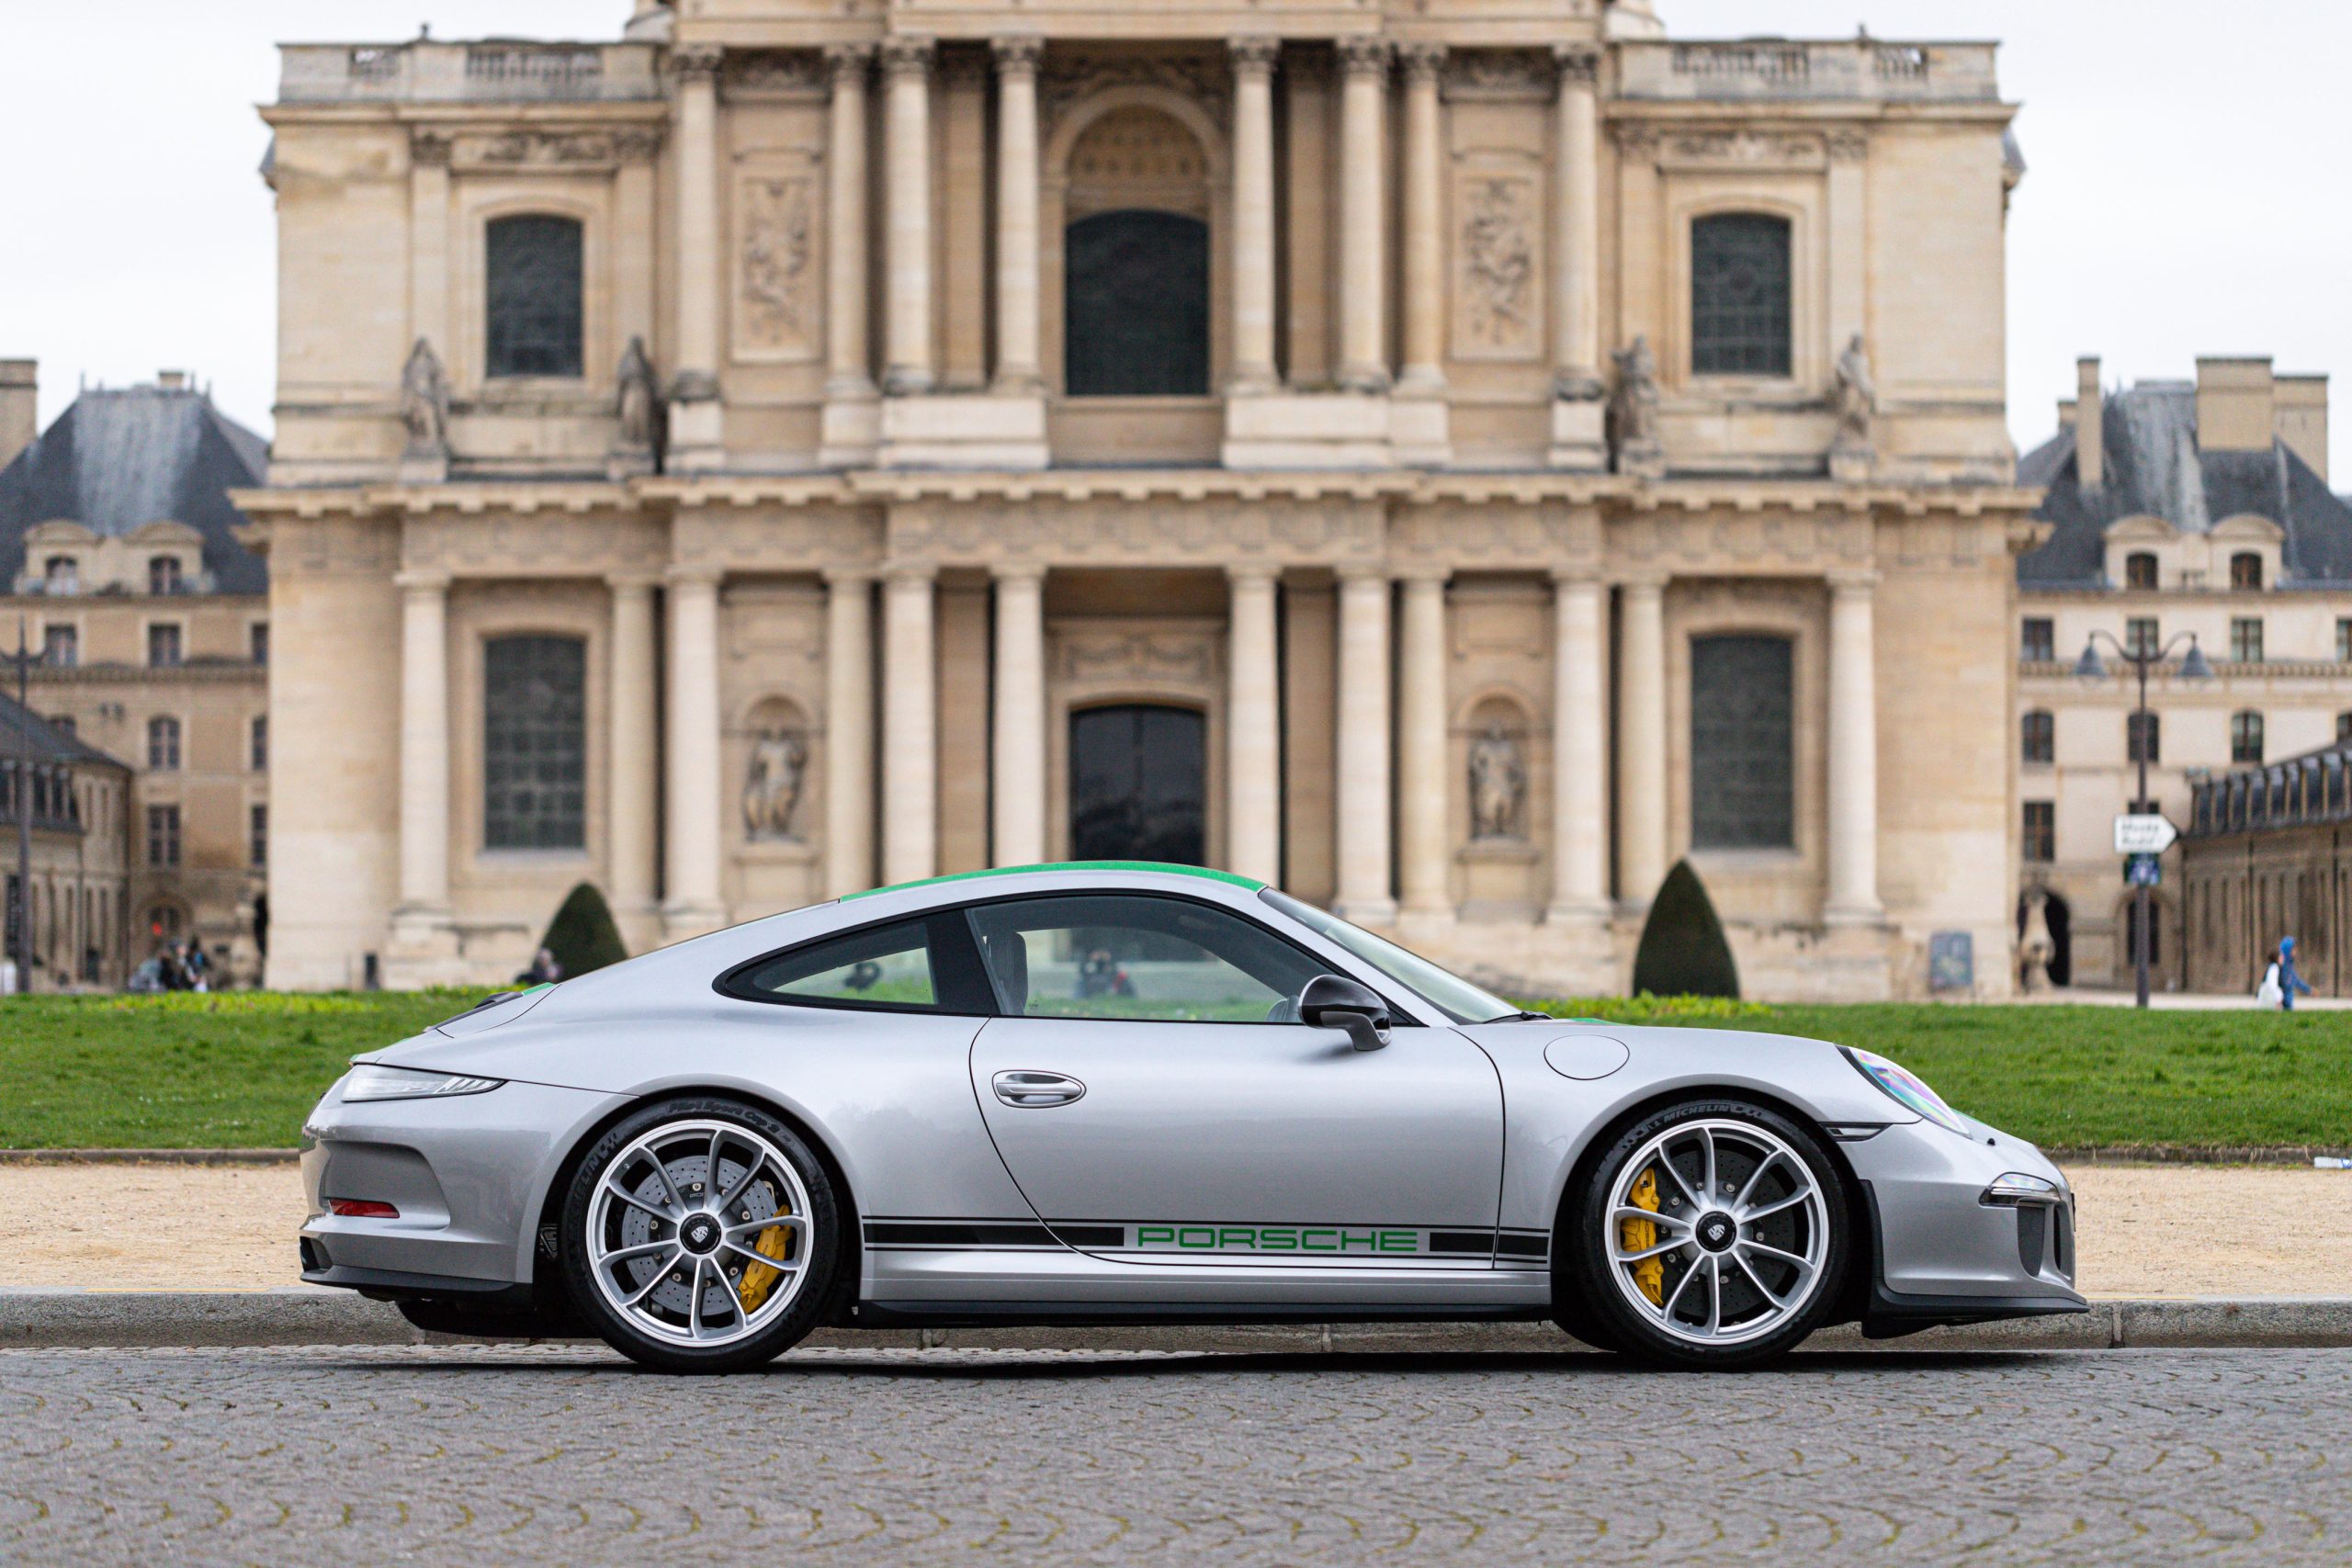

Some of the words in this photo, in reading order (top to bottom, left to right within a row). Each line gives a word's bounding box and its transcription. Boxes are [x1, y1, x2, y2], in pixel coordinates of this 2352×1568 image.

[669, 1101, 703, 1113] Pilot
[703, 1101, 743, 1116] Sport
[744, 1111, 767, 1126] Cup
[767, 1123, 781, 1134] 2
[1664, 1104, 1730, 1122] MICHELIN
[1137, 1227, 1419, 1252] PORSCHE
